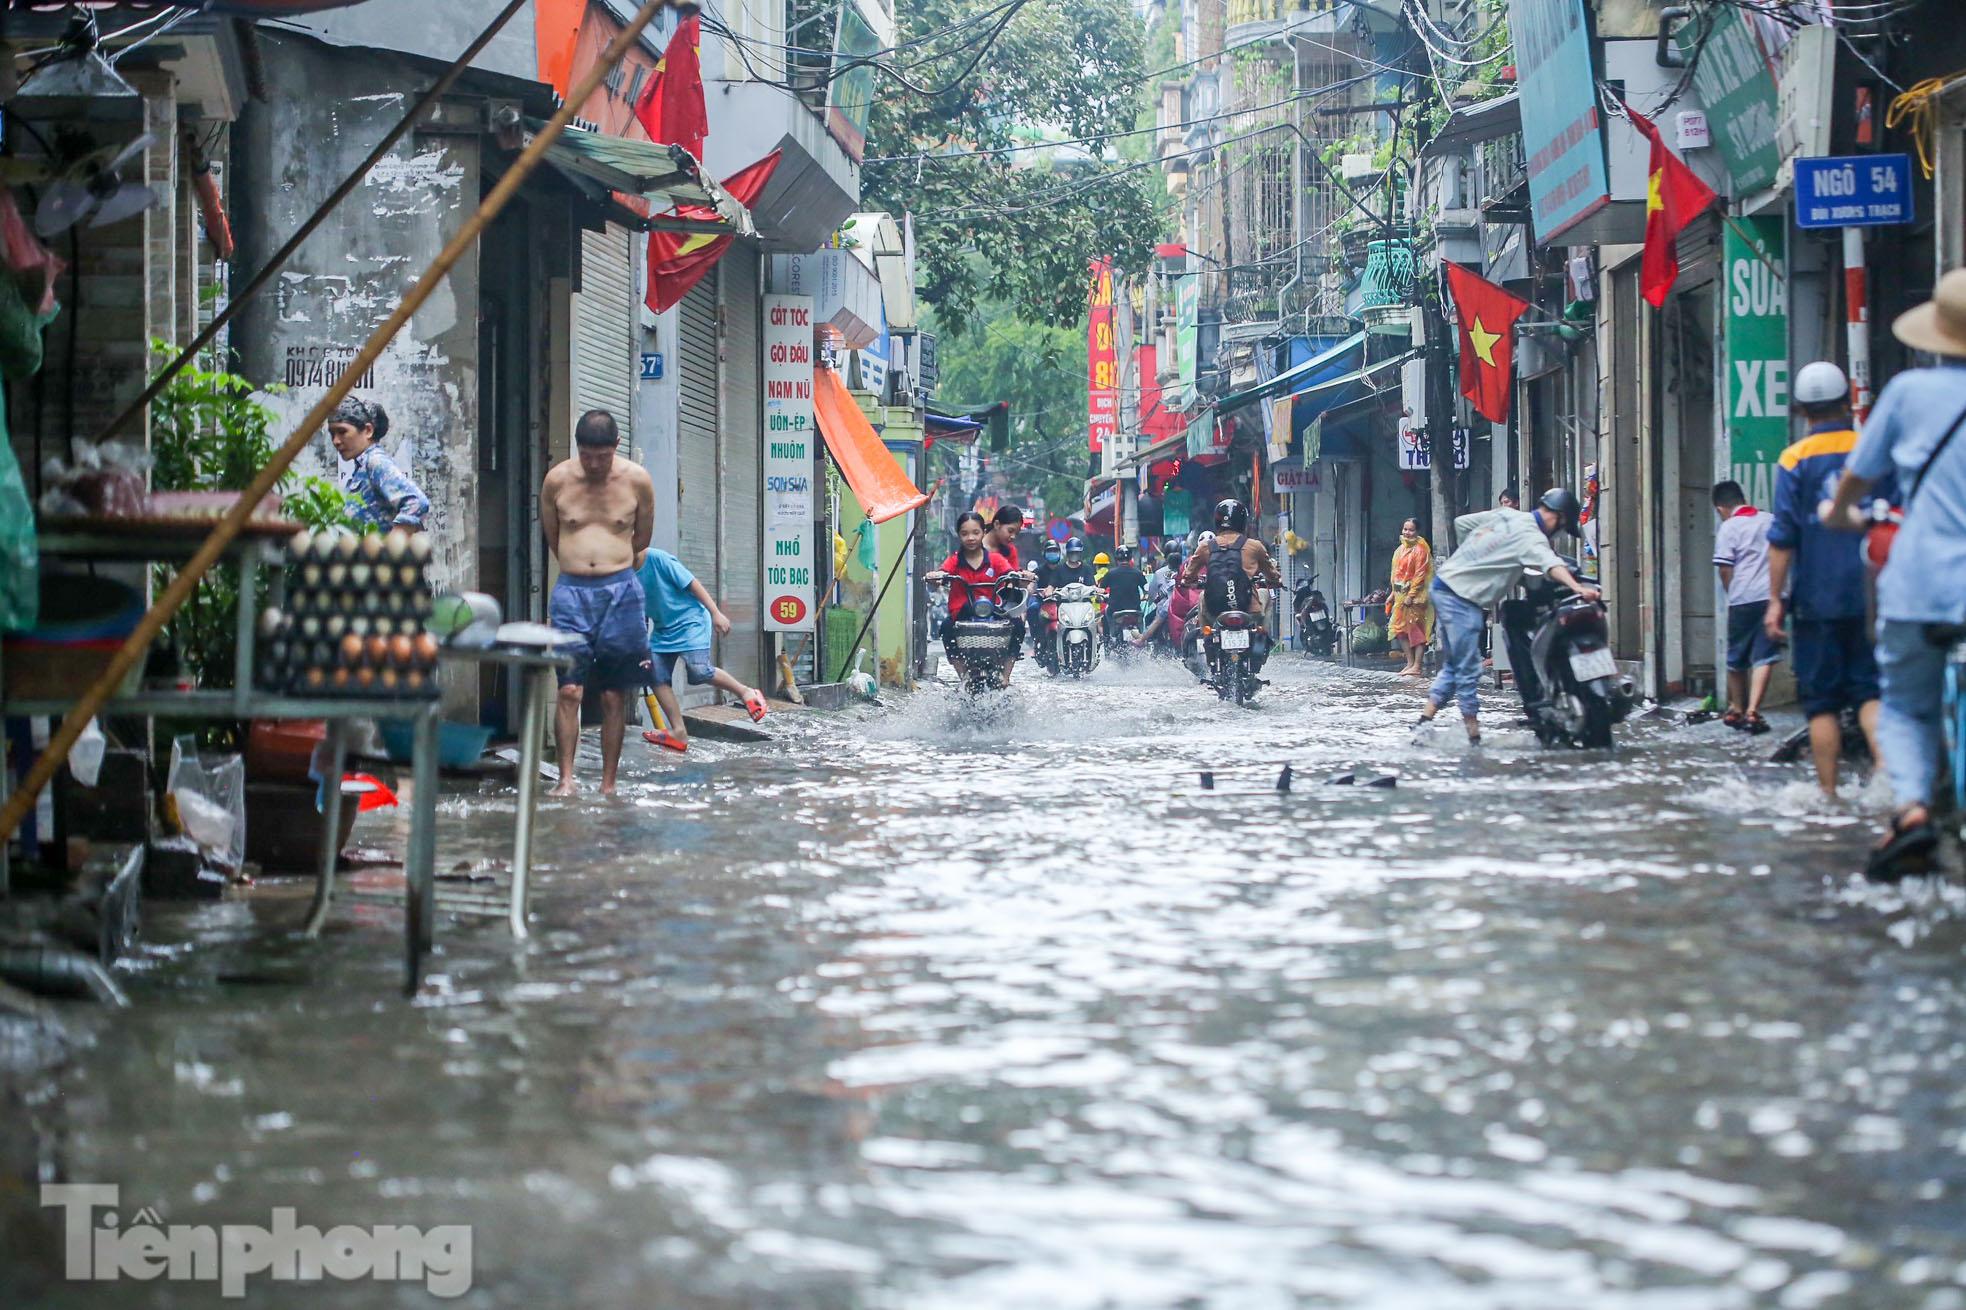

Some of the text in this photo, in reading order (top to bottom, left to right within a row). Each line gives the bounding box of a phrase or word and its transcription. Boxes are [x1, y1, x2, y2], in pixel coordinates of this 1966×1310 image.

[1813, 163, 1898, 197] NGÕ 54
[1733, 239, 1788, 317] SỬA
[771, 300, 808, 326] CẮT TÓC
[771, 341, 786, 366] GỘI
[769, 378, 810, 399] NAM NỮ
[1735, 360, 1788, 416] XE
[771, 440, 804, 462] NHUỘM
[776, 534, 800, 556] NHỔ
[768, 563, 809, 588] TÓC BẠC
[1226, 579, 1239, 609] didas
[780, 602, 797, 618] 59
